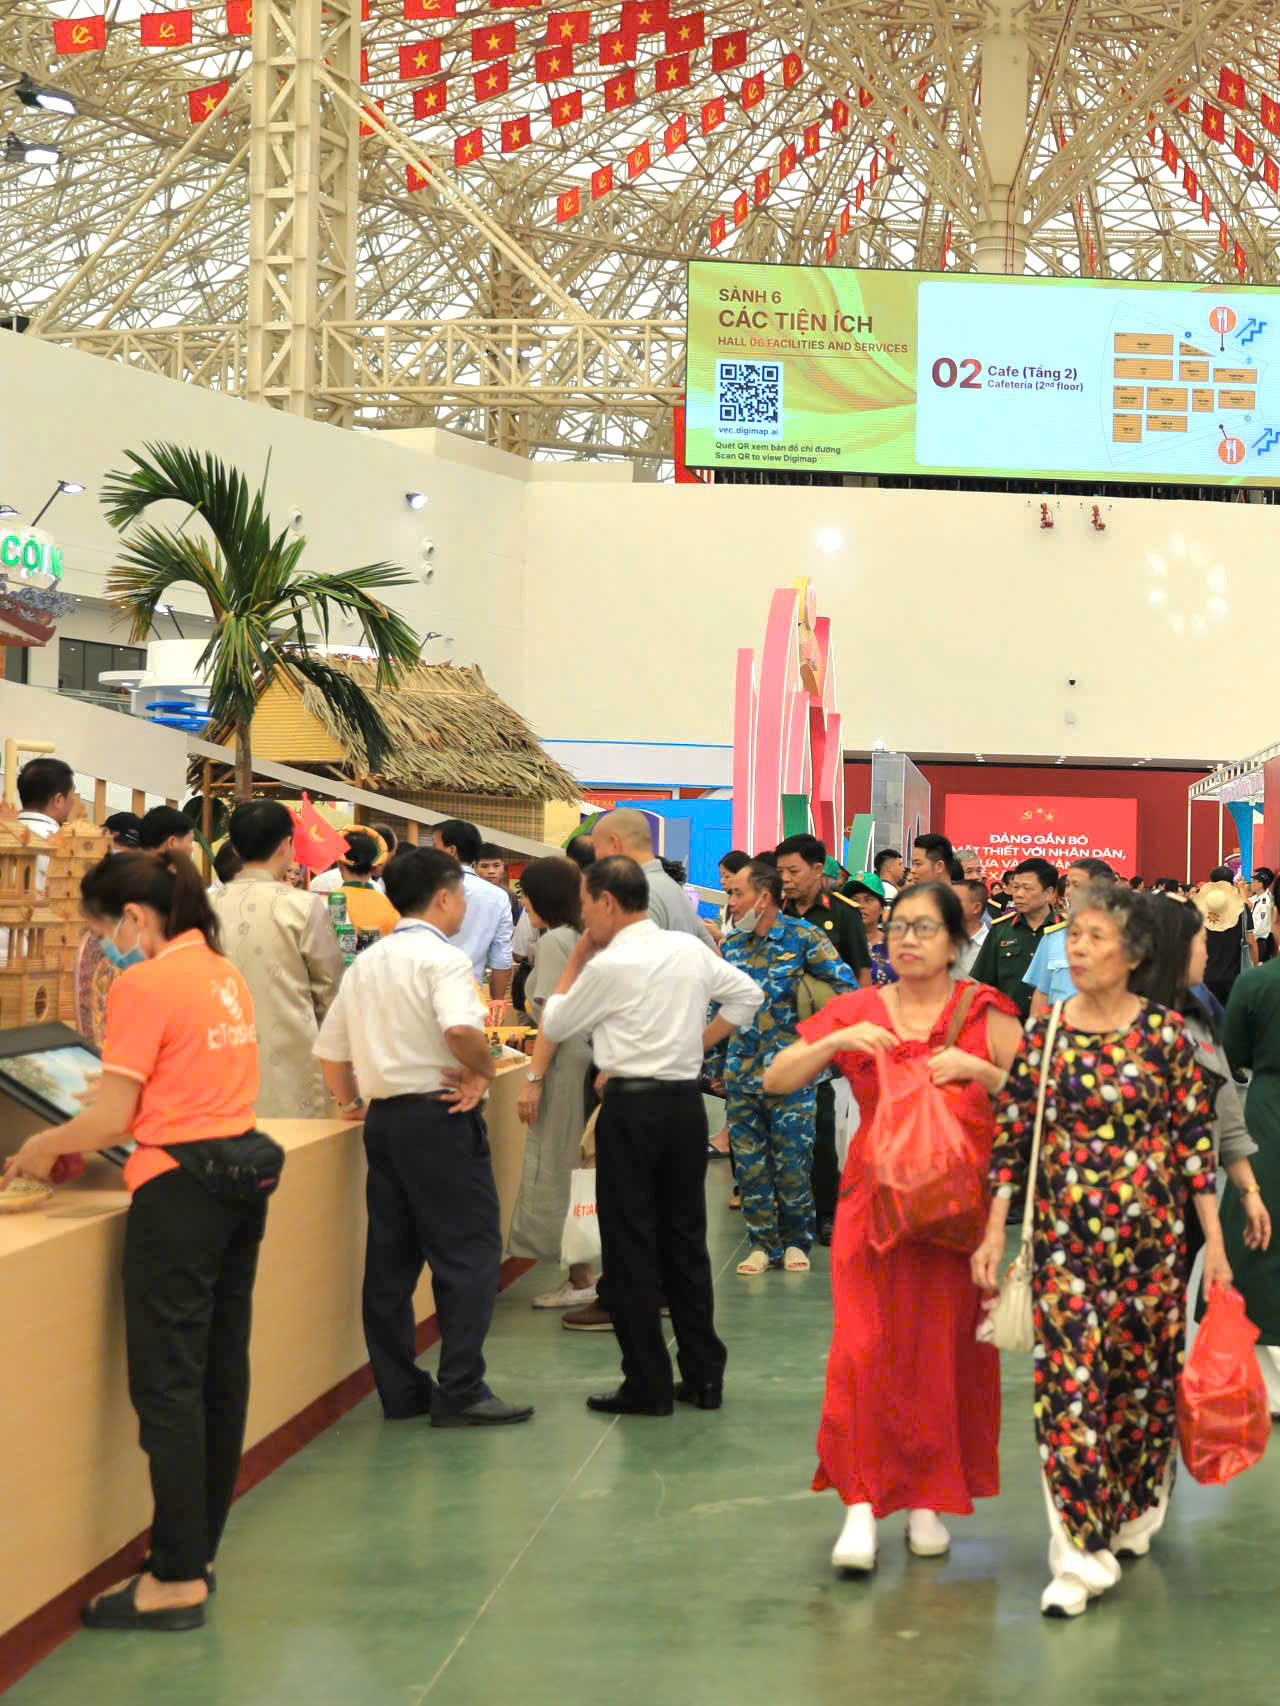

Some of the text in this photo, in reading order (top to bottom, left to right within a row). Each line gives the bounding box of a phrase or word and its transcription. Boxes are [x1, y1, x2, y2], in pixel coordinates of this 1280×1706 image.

[771, 291, 782, 304] 6
[718, 306, 873, 335] CÁC TIỆN ÍCH
[718, 336, 908, 353] HALL 06 FACILITIES AND SERVICES
[931, 357, 982, 389] 02
[987, 364, 1077, 381] Cafe (Tầng 2)
[987, 380, 1033, 390] Cafeteria
[1056, 382, 1084, 392] floor)
[718, 426, 779, 436] vec.digimap.ai
[715, 441, 736, 450] Quét
[737, 442, 750, 450] QR
[715, 451, 736, 459] Scan
[762, 454, 781, 462] view
[783, 454, 817, 464] Digimap
[982, 844, 1019, 856] THIẾT
[1021, 846, 1046, 857] VỚI
[1048, 847, 1090, 857] NHÂN
[1092, 848, 1127, 860] DÂN,
